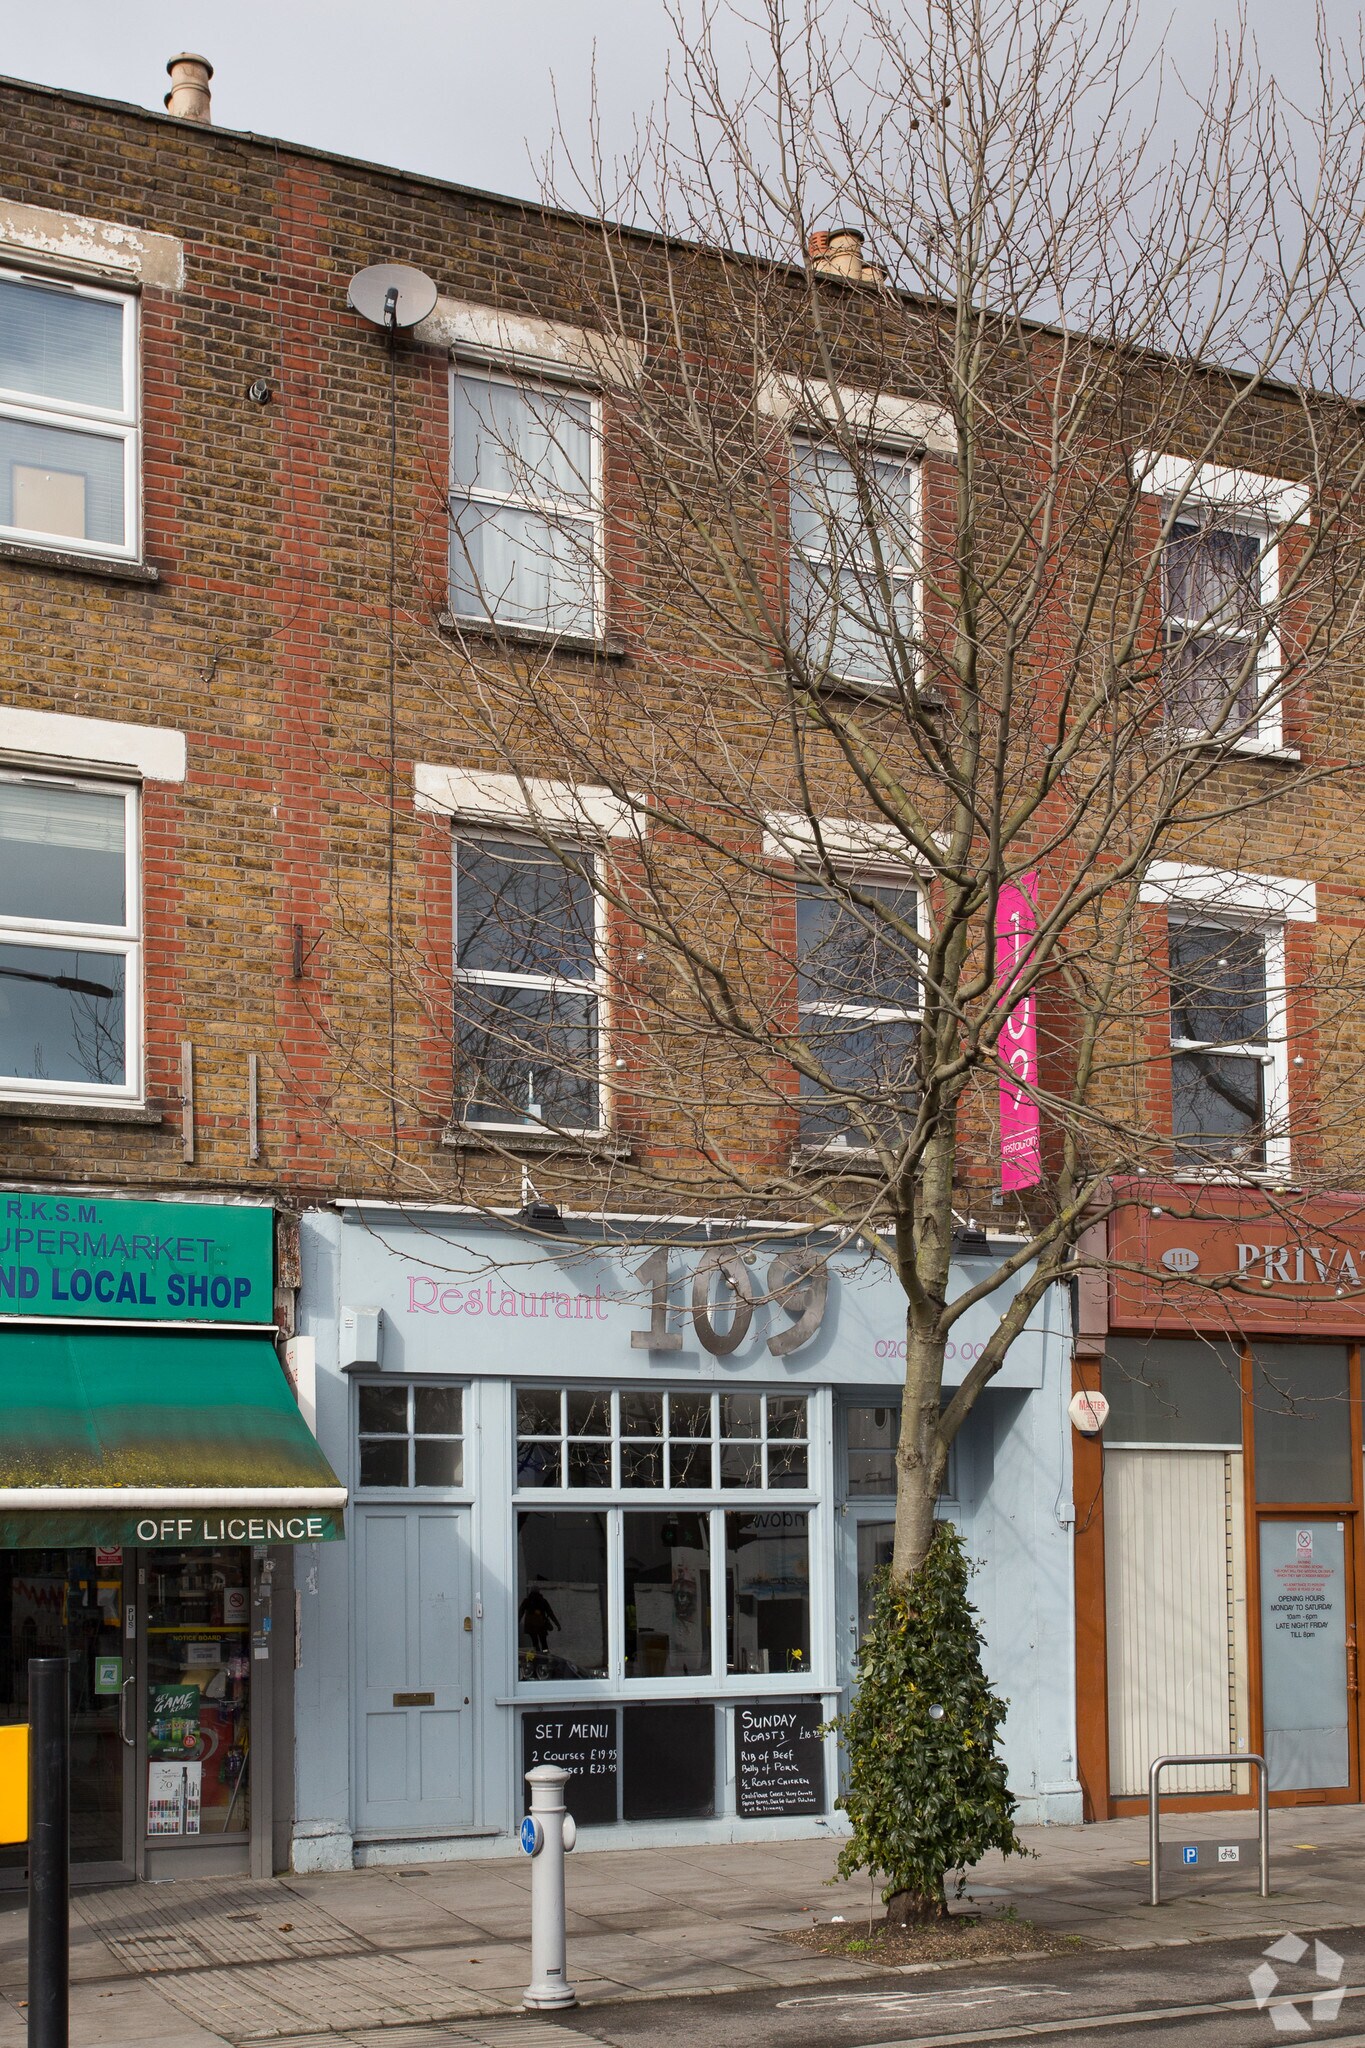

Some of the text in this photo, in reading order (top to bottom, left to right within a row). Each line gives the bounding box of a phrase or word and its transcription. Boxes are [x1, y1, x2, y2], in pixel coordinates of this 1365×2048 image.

[7, 1200, 103, 1224] R.K.S.M.
[1171, 1252, 1191, 1266] 111
[52, 1268, 157, 1305] LOCAL
[166, 1274, 251, 1309] SHOP
[406, 1247, 829, 1357] Restaurant 109
[1079, 1399, 1105, 1411] MASTER
[137, 1518, 323, 1542] OFF LICENCE
[154, 1692, 195, 1713] GAME
[741, 1711, 797, 1729] SUNDAY
[535, 1724, 608, 1739] SET MENU
[743, 1730, 785, 1743] ROASTS
[532, 1750, 539, 1762] 2
[543, 1750, 585, 1760] Courses
[758, 1751, 769, 1764] of
[762, 1763, 771, 1775] of
[1186, 1849, 1196, 1862] P
